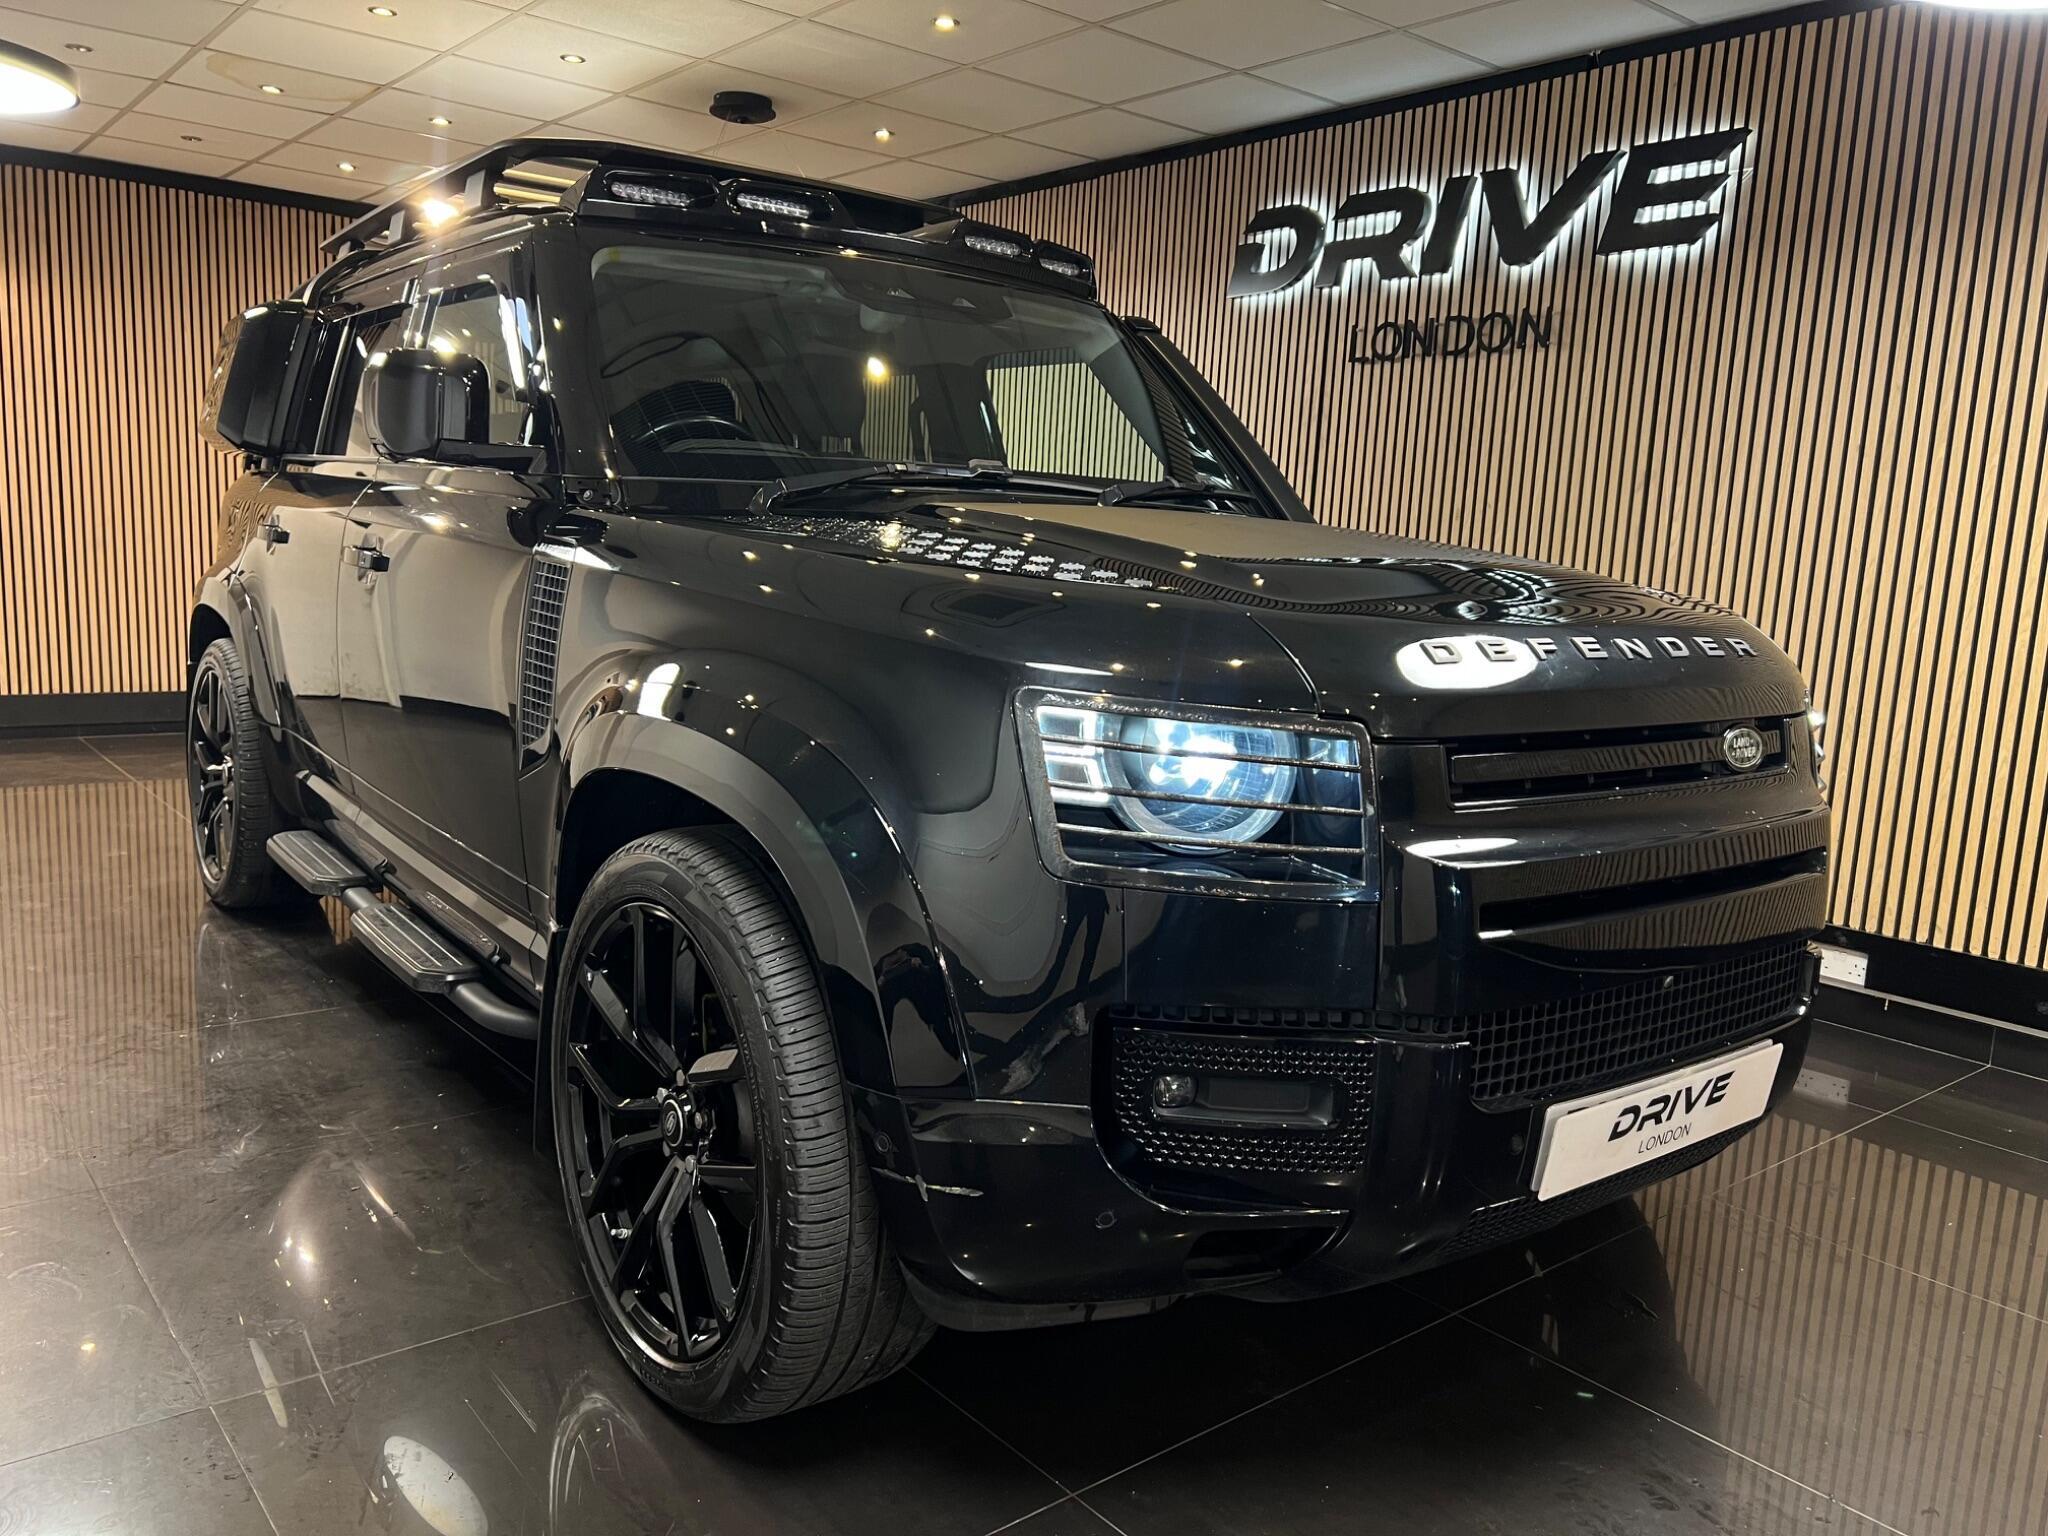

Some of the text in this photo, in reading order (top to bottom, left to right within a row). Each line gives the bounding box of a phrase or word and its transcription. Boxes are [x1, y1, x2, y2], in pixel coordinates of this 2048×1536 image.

[1227, 127, 1752, 299] DRIVE
[1349, 305, 1553, 364] LONDON
[1419, 636, 1758, 665] DEFENDER
[1607, 1070, 1735, 1142] DRIVE
[1638, 1122, 1692, 1154] LONDON
